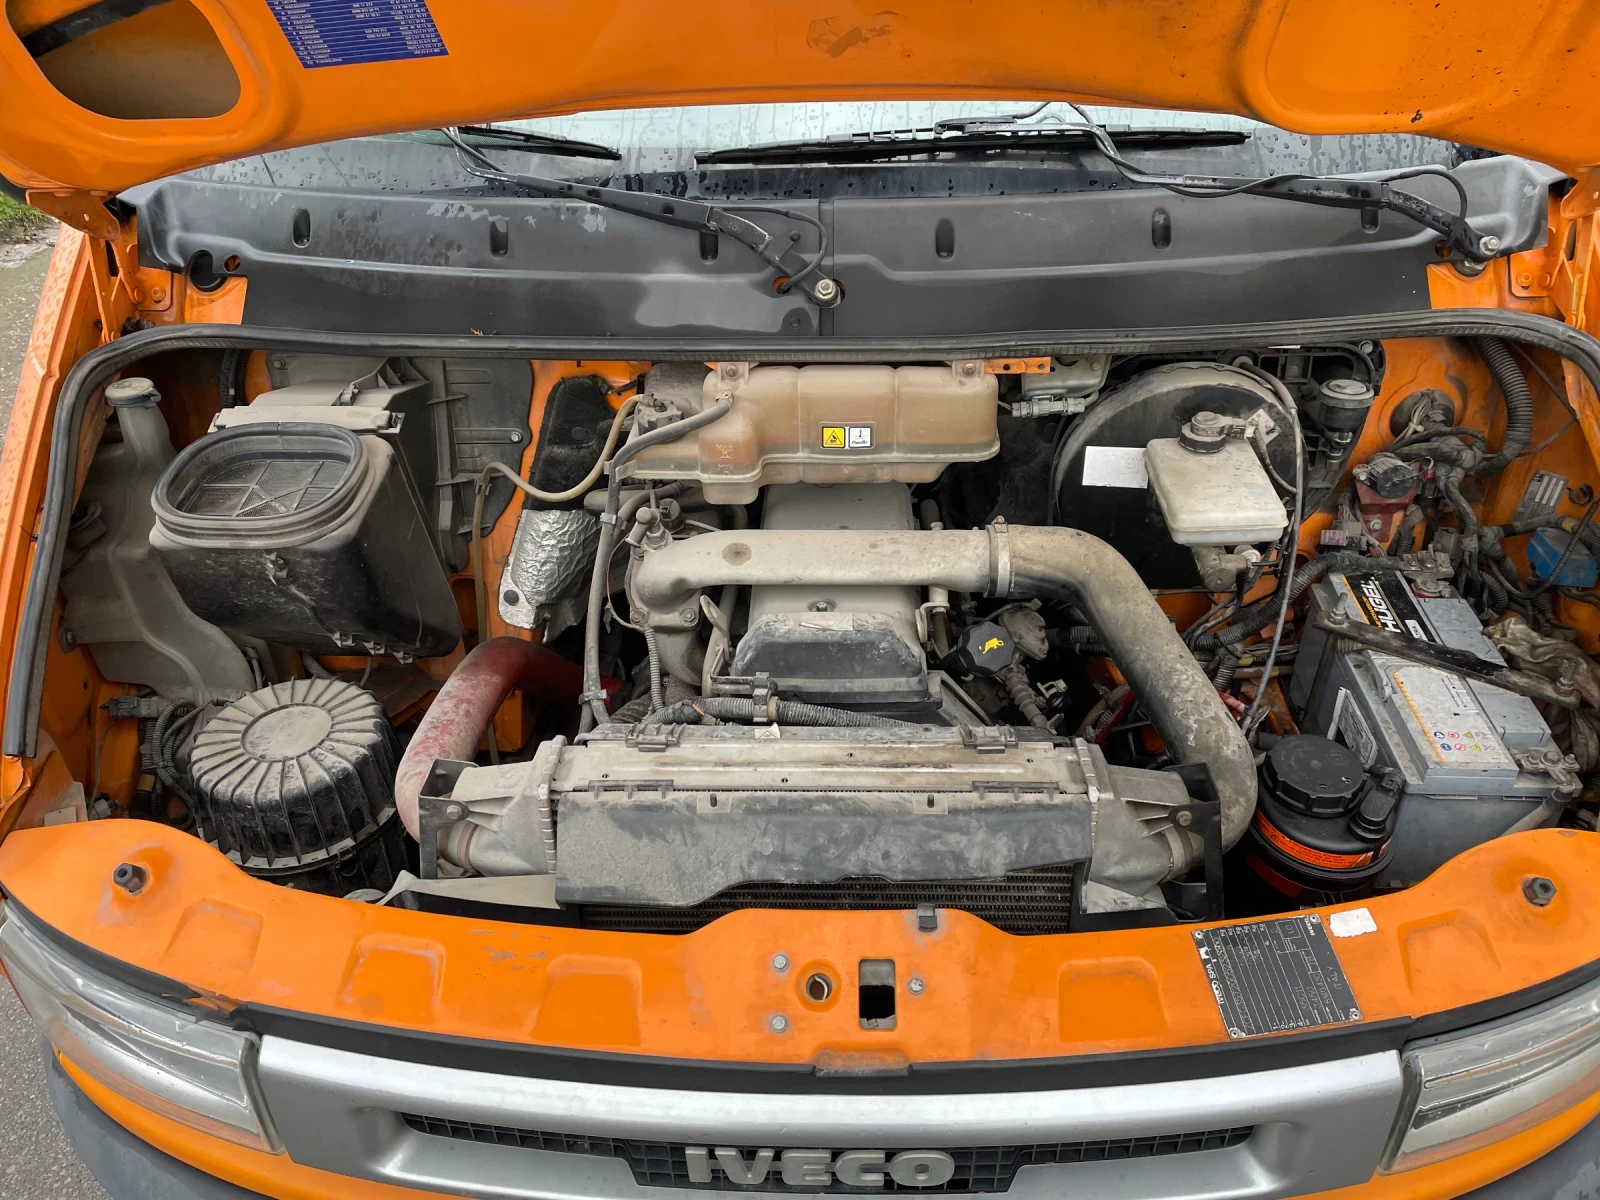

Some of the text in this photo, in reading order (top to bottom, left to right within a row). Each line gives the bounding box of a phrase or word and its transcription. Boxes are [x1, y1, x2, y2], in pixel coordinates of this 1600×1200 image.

[1360, 580, 1401, 632] HUGEL
[1327, 966, 1342, 989] ITALY
[685, 1146, 955, 1186] IVECO
